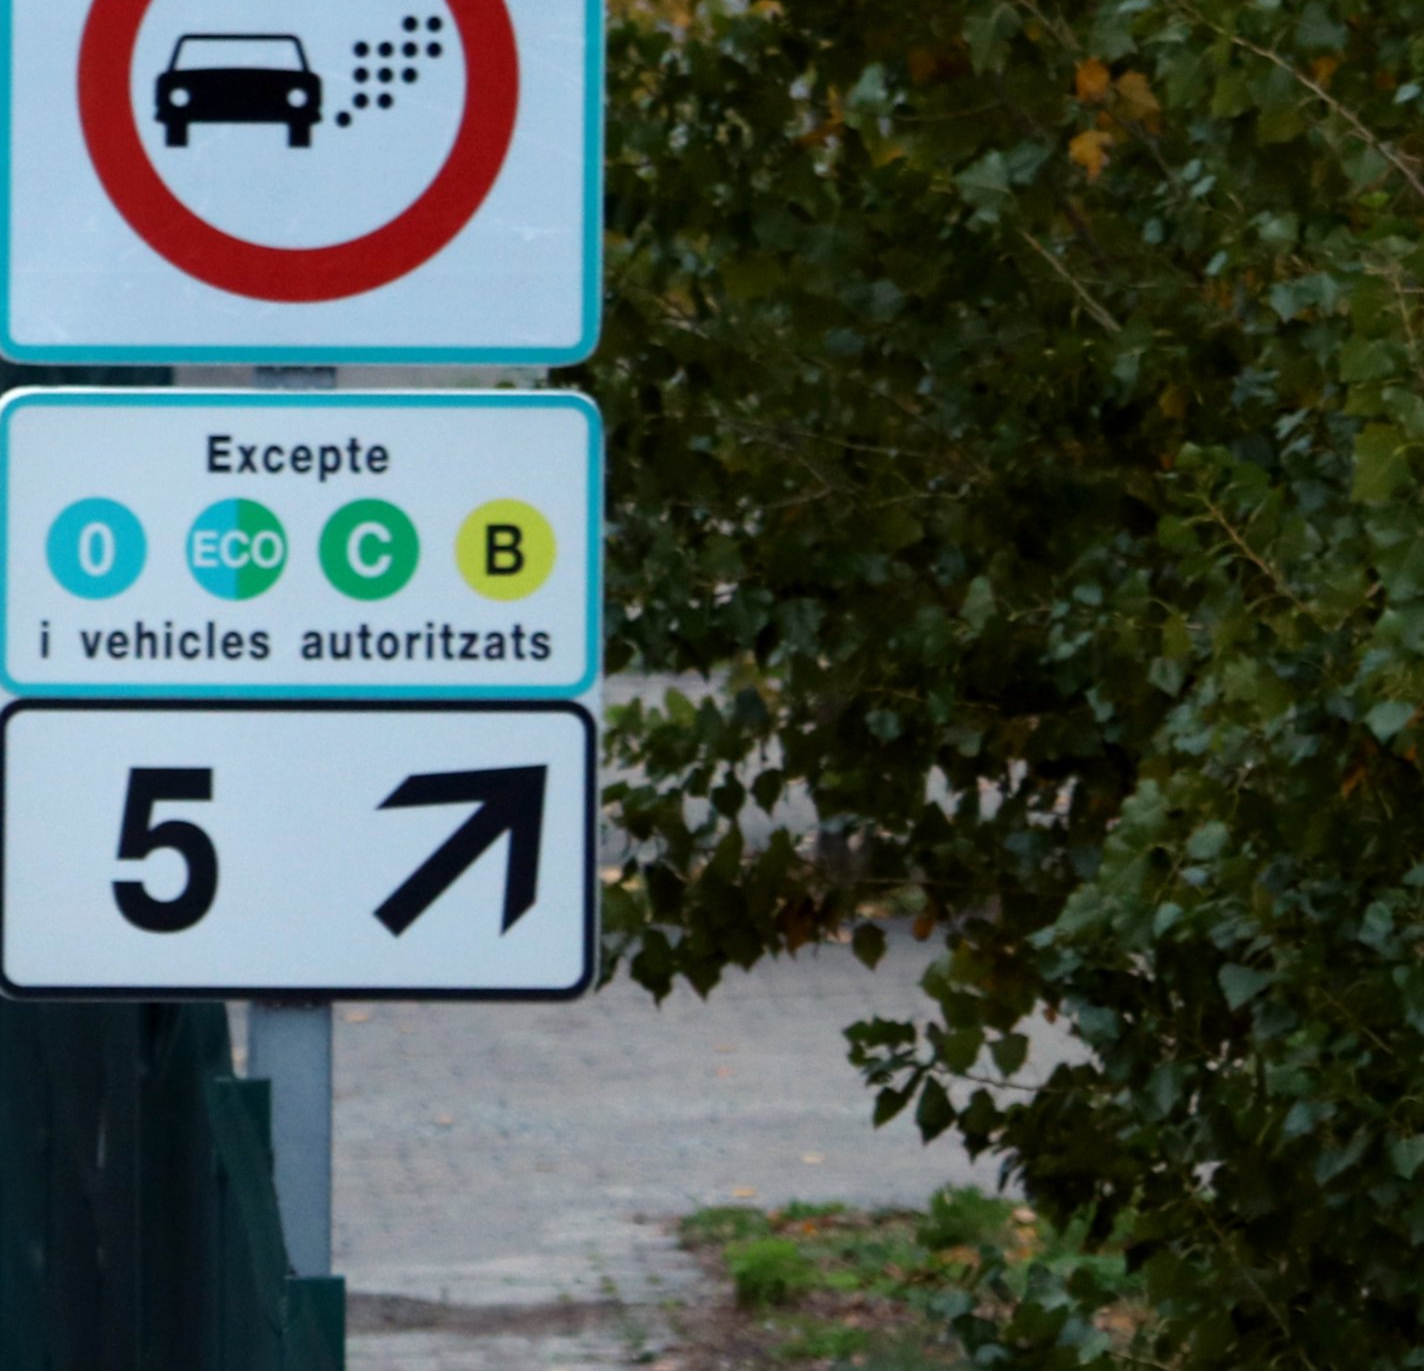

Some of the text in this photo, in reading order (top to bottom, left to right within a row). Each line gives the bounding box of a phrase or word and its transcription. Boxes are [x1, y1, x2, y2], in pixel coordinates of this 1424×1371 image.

[208, 435, 388, 482] Excepte
[192, 530, 284, 569] ECO
[348, 522, 391, 577] C
[486, 524, 524, 575] B
[40, 620, 551, 661] i vehicles autoritzats
[111, 766, 220, 934] 5
